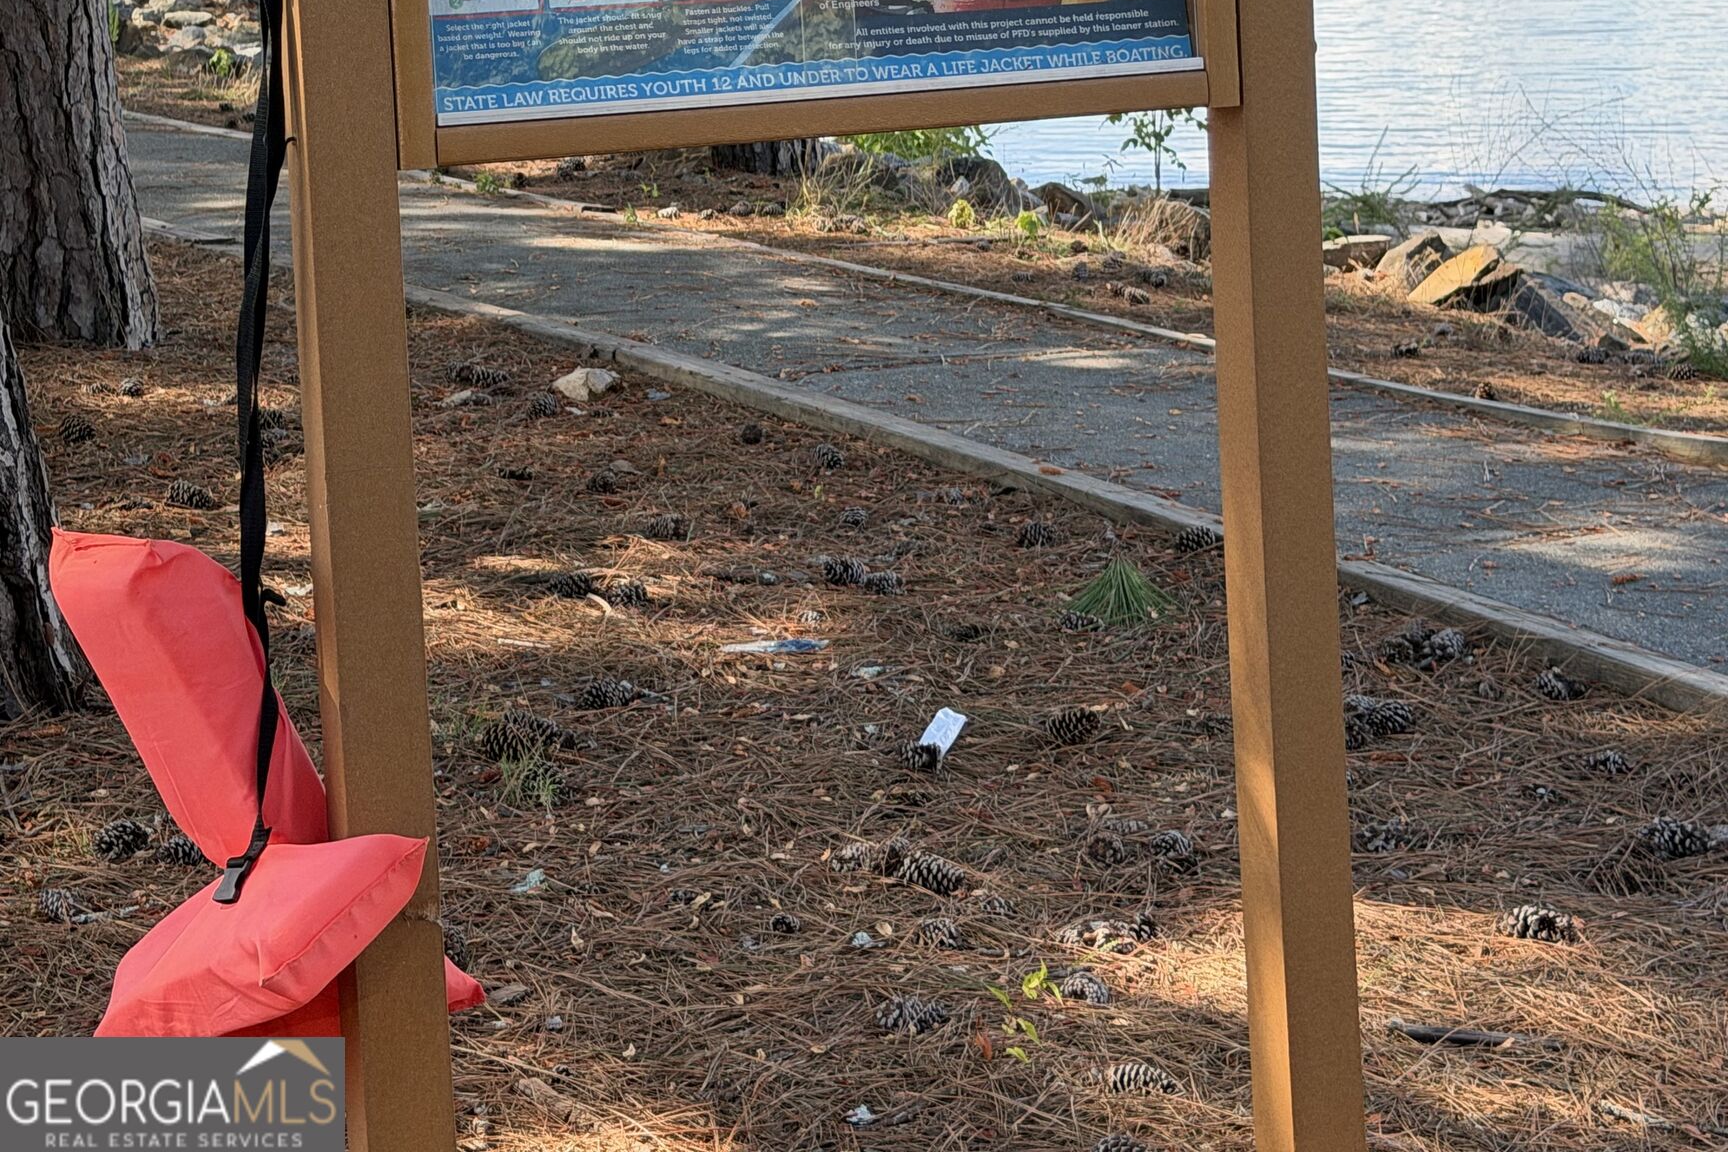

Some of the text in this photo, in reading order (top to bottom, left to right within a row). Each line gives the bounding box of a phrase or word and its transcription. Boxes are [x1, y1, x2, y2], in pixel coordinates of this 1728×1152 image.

[685, 8, 710, 16] Fasten
[711, 6, 722, 14] all
[819, 0, 880, 11] of Engineers
[559, 16, 574, 24] The
[575, 15, 600, 25] jacket
[856, 9, 1149, 37] All entities involved with this project cannot be held responsible
[446, 24, 470, 32] Select
[507, 20, 530, 29] jacket
[614, 23, 637, 31] chest
[685, 27, 714, 35] Smaller
[715, 26, 742, 34] jackets
[437, 34, 460, 42] based
[507, 30, 541, 38] Wearing
[559, 37, 587, 45] should
[647, 32, 666, 40] your
[704, 36, 724, 44] strap
[725, 34, 736, 42] for
[829, 41, 842, 49] for
[844, 42, 860, 50] any
[863, 40, 891, 49] injury
[905, 36, 932, 45] death
[934, 35, 952, 43] due
[954, 34, 964, 42] to
[966, 32, 999, 41] misuse
[1000, 30, 1010, 39] of
[1012, 29, 1036, 38] PFD's
[1038, 25, 1078, 38] supplied
[1080, 25, 1091, 35] by
[1093, 24, 1110, 33] this
[1111, 23, 1142, 32] loaner
[1144, 19, 1179, 29] station.
[445, 43, 469, 52] jacket
[512, 40, 525, 48] big
[577, 46, 598, 54] body
[600, 43, 608, 51] in
[683, 47, 700, 55] legs
[713, 44, 738, 52] added
[443, 45, 1188, 111] STATE LAW REQUIRES YOUTH 12 AND UNDER TO WEAR A LIFE JACKET WHILE BOATING.
